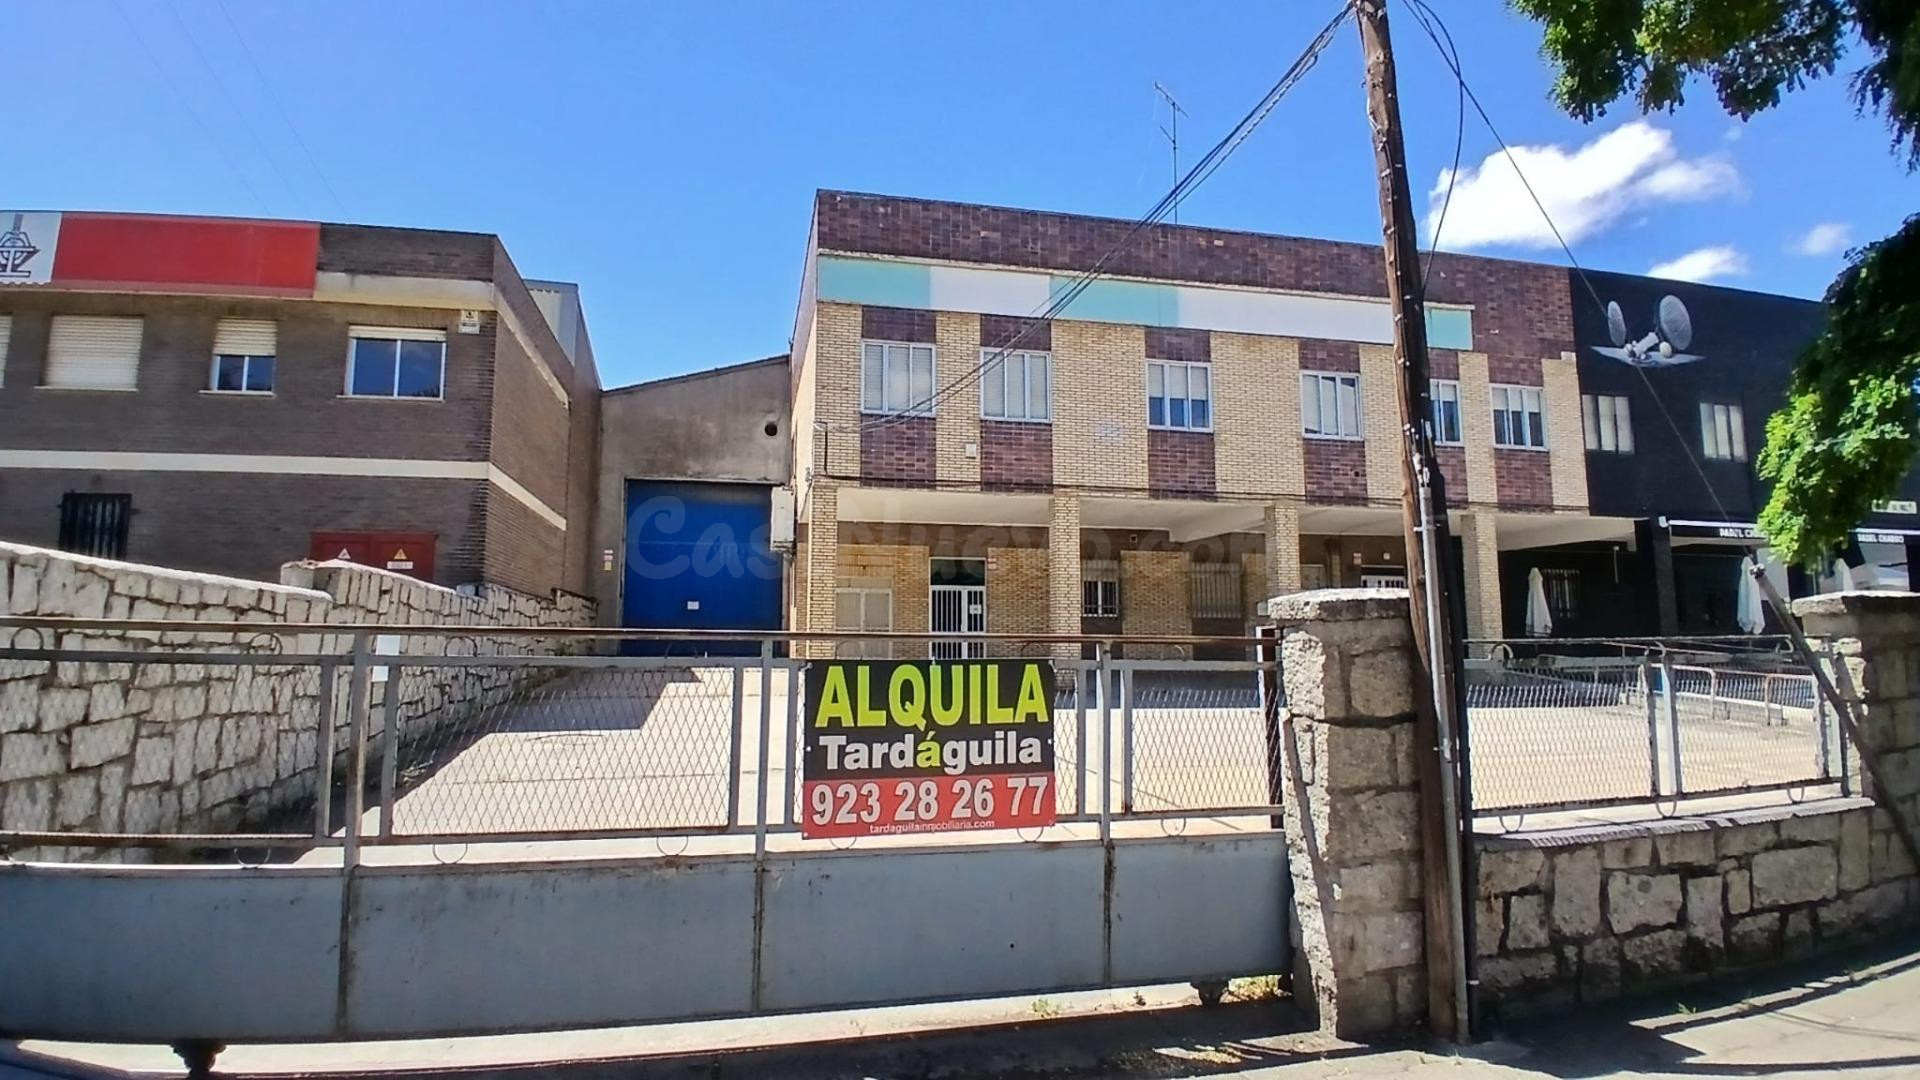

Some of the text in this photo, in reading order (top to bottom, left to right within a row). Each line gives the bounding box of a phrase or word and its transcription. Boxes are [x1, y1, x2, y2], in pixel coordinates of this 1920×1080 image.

[814, 663, 1049, 731] ALQUILA
[819, 731, 1042, 776] Tardáguila
[811, 776, 1048, 826] 923 28 26 77
